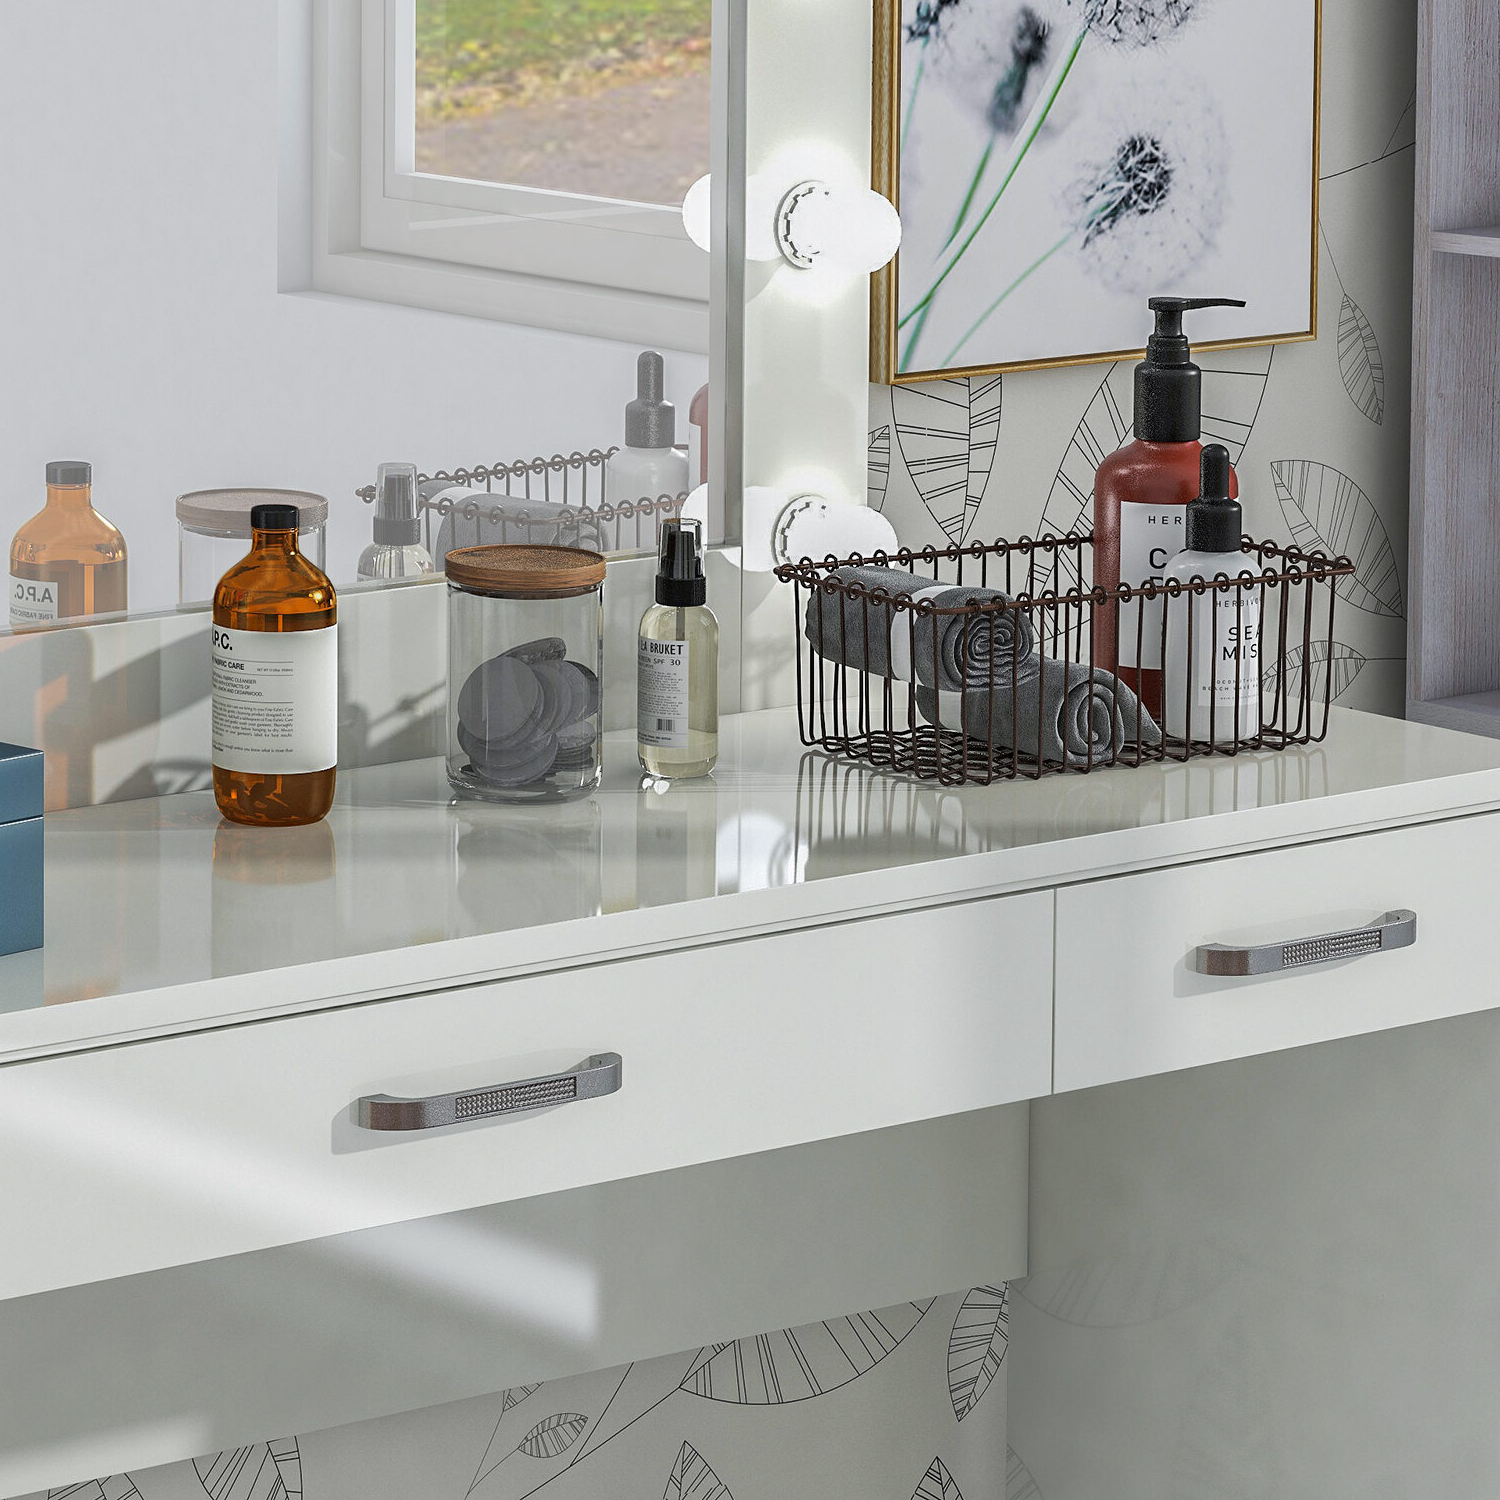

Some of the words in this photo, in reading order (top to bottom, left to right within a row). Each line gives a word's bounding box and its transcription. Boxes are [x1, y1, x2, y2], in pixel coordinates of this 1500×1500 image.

[650, 641, 684, 655] BRUKET
[228, 661, 245, 671] CARE
[670, 658, 681, 666] 30
